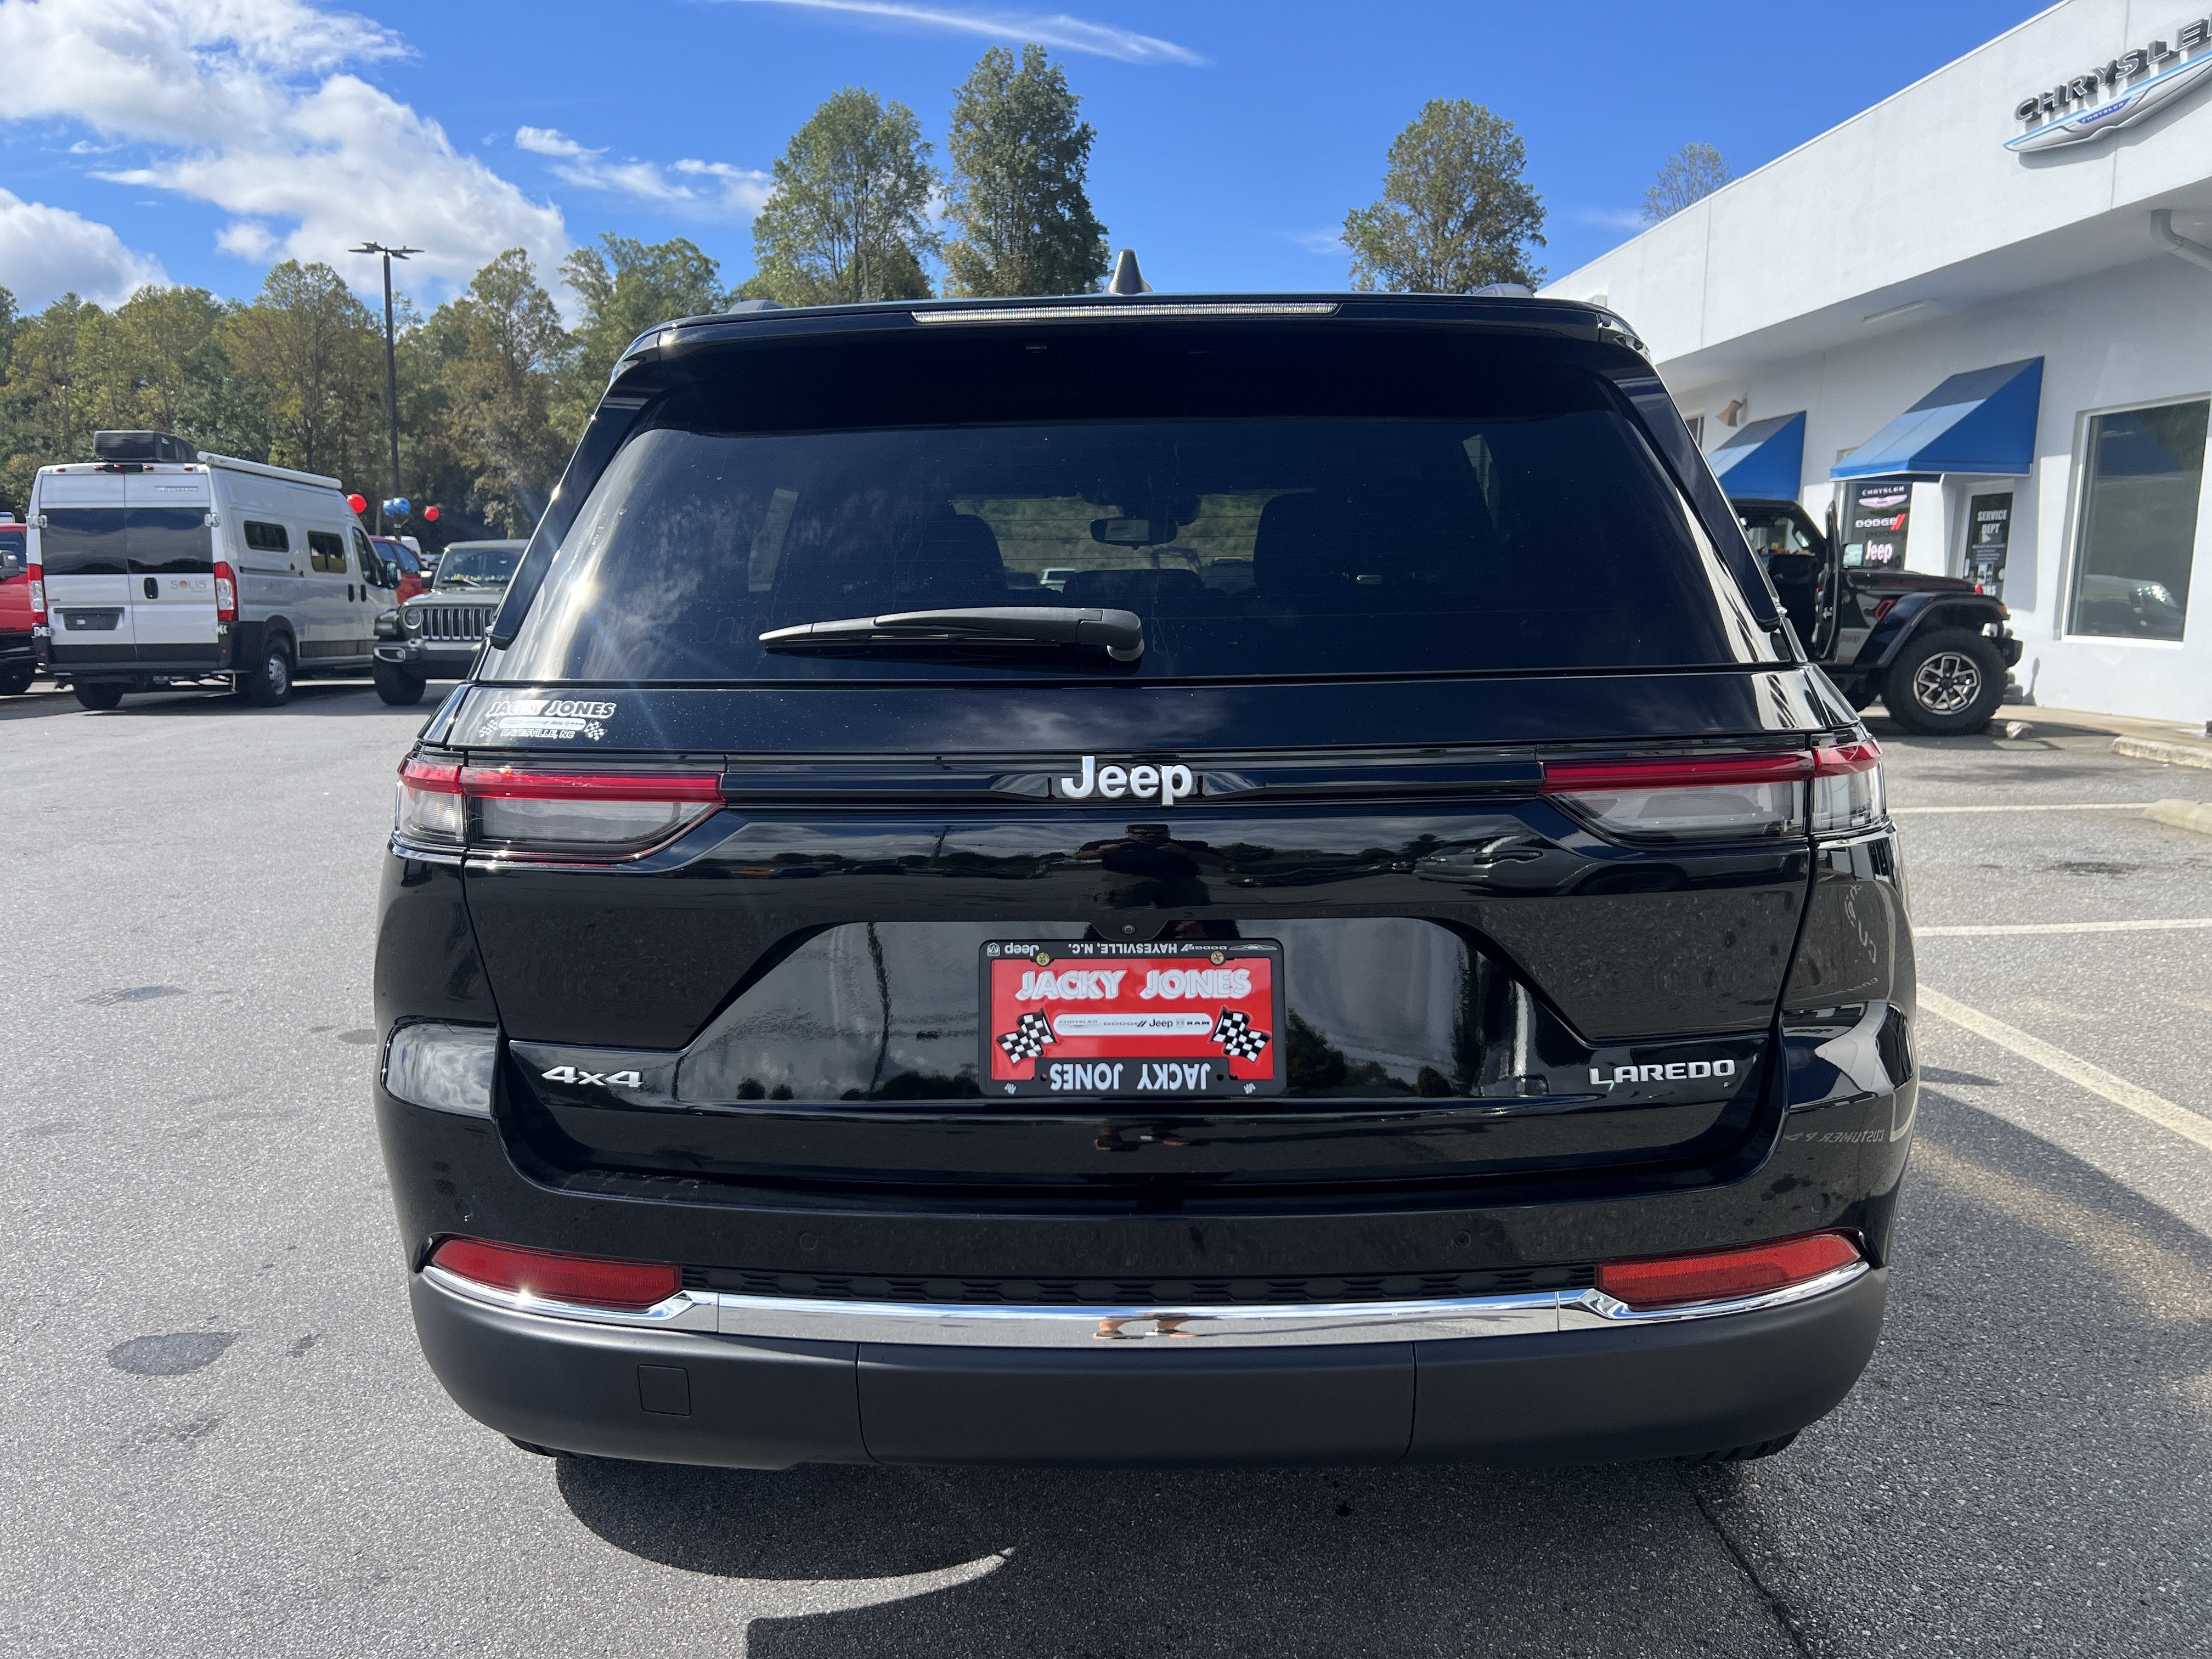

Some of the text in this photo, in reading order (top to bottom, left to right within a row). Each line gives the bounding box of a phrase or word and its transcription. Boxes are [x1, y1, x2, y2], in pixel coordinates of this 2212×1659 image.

[2014, 13, 2212, 122] CHRYSLE
[1861, 486, 1905, 496] CHRYSLER
[1855, 517, 1898, 528] DODGE
[1977, 509, 2008, 522] SERVICE
[1982, 523, 2000, 534] DEPT
[1865, 539, 1893, 563] Jeep
[485, 700, 617, 719] JACY JONES
[559, 730, 575, 738] NC
[1061, 755, 1192, 806] Jeep
[1004, 942, 1040, 957] Jeep
[1068, 943, 1093, 955] N.C.
[1097, 943, 1177, 954] HAYESVILLE,
[1015, 969, 1252, 1000] JACKY JONES
[1149, 1019, 1173, 1028] Jeep
[541, 1066, 645, 1087] 4x4
[1049, 1062, 1211, 1091] JACKY JONES
[1589, 1059, 1735, 1085] LAREDO
